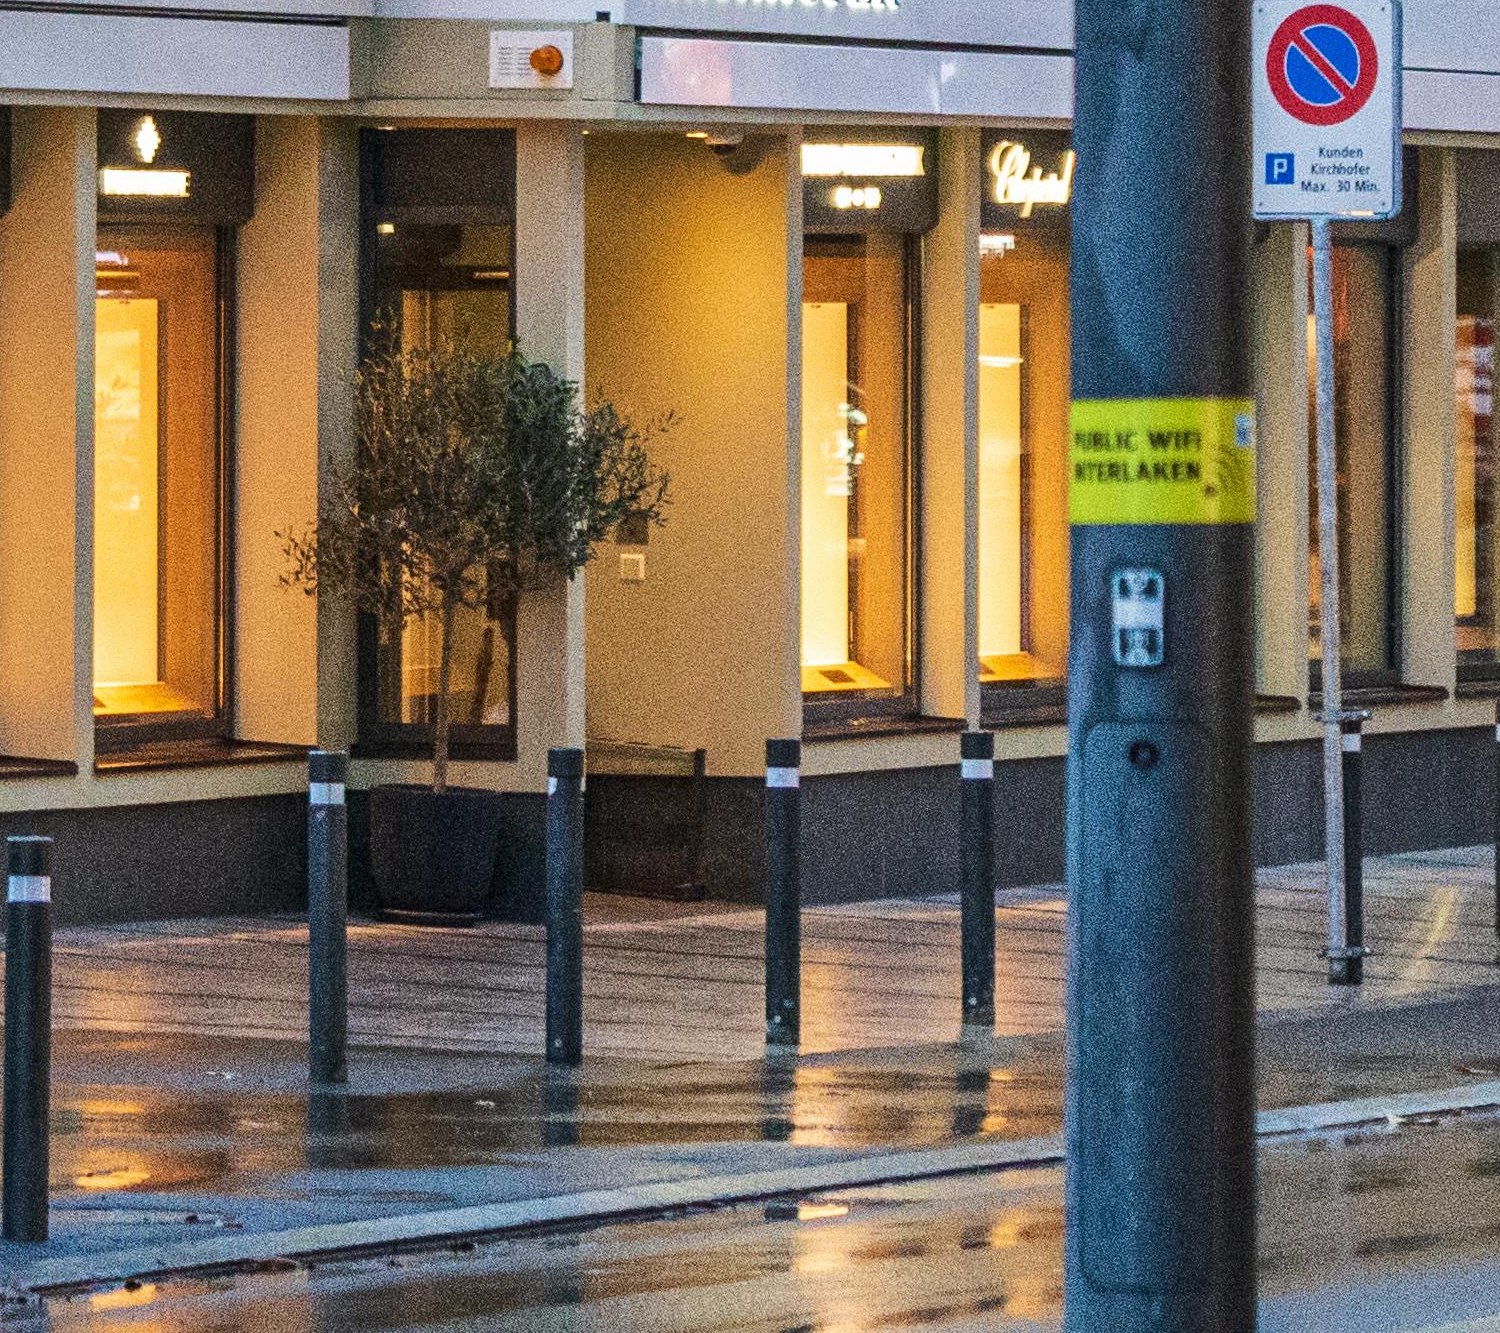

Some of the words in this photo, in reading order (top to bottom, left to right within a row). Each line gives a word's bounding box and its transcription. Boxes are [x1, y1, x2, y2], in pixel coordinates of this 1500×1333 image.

[1319, 147, 1364, 159] Kunden
[1311, 163, 1370, 176] Kirchhofer
[1302, 180, 1330, 192] Max.
[1337, 180, 1350, 192] 30
[1355, 180, 1380, 192] Min.
